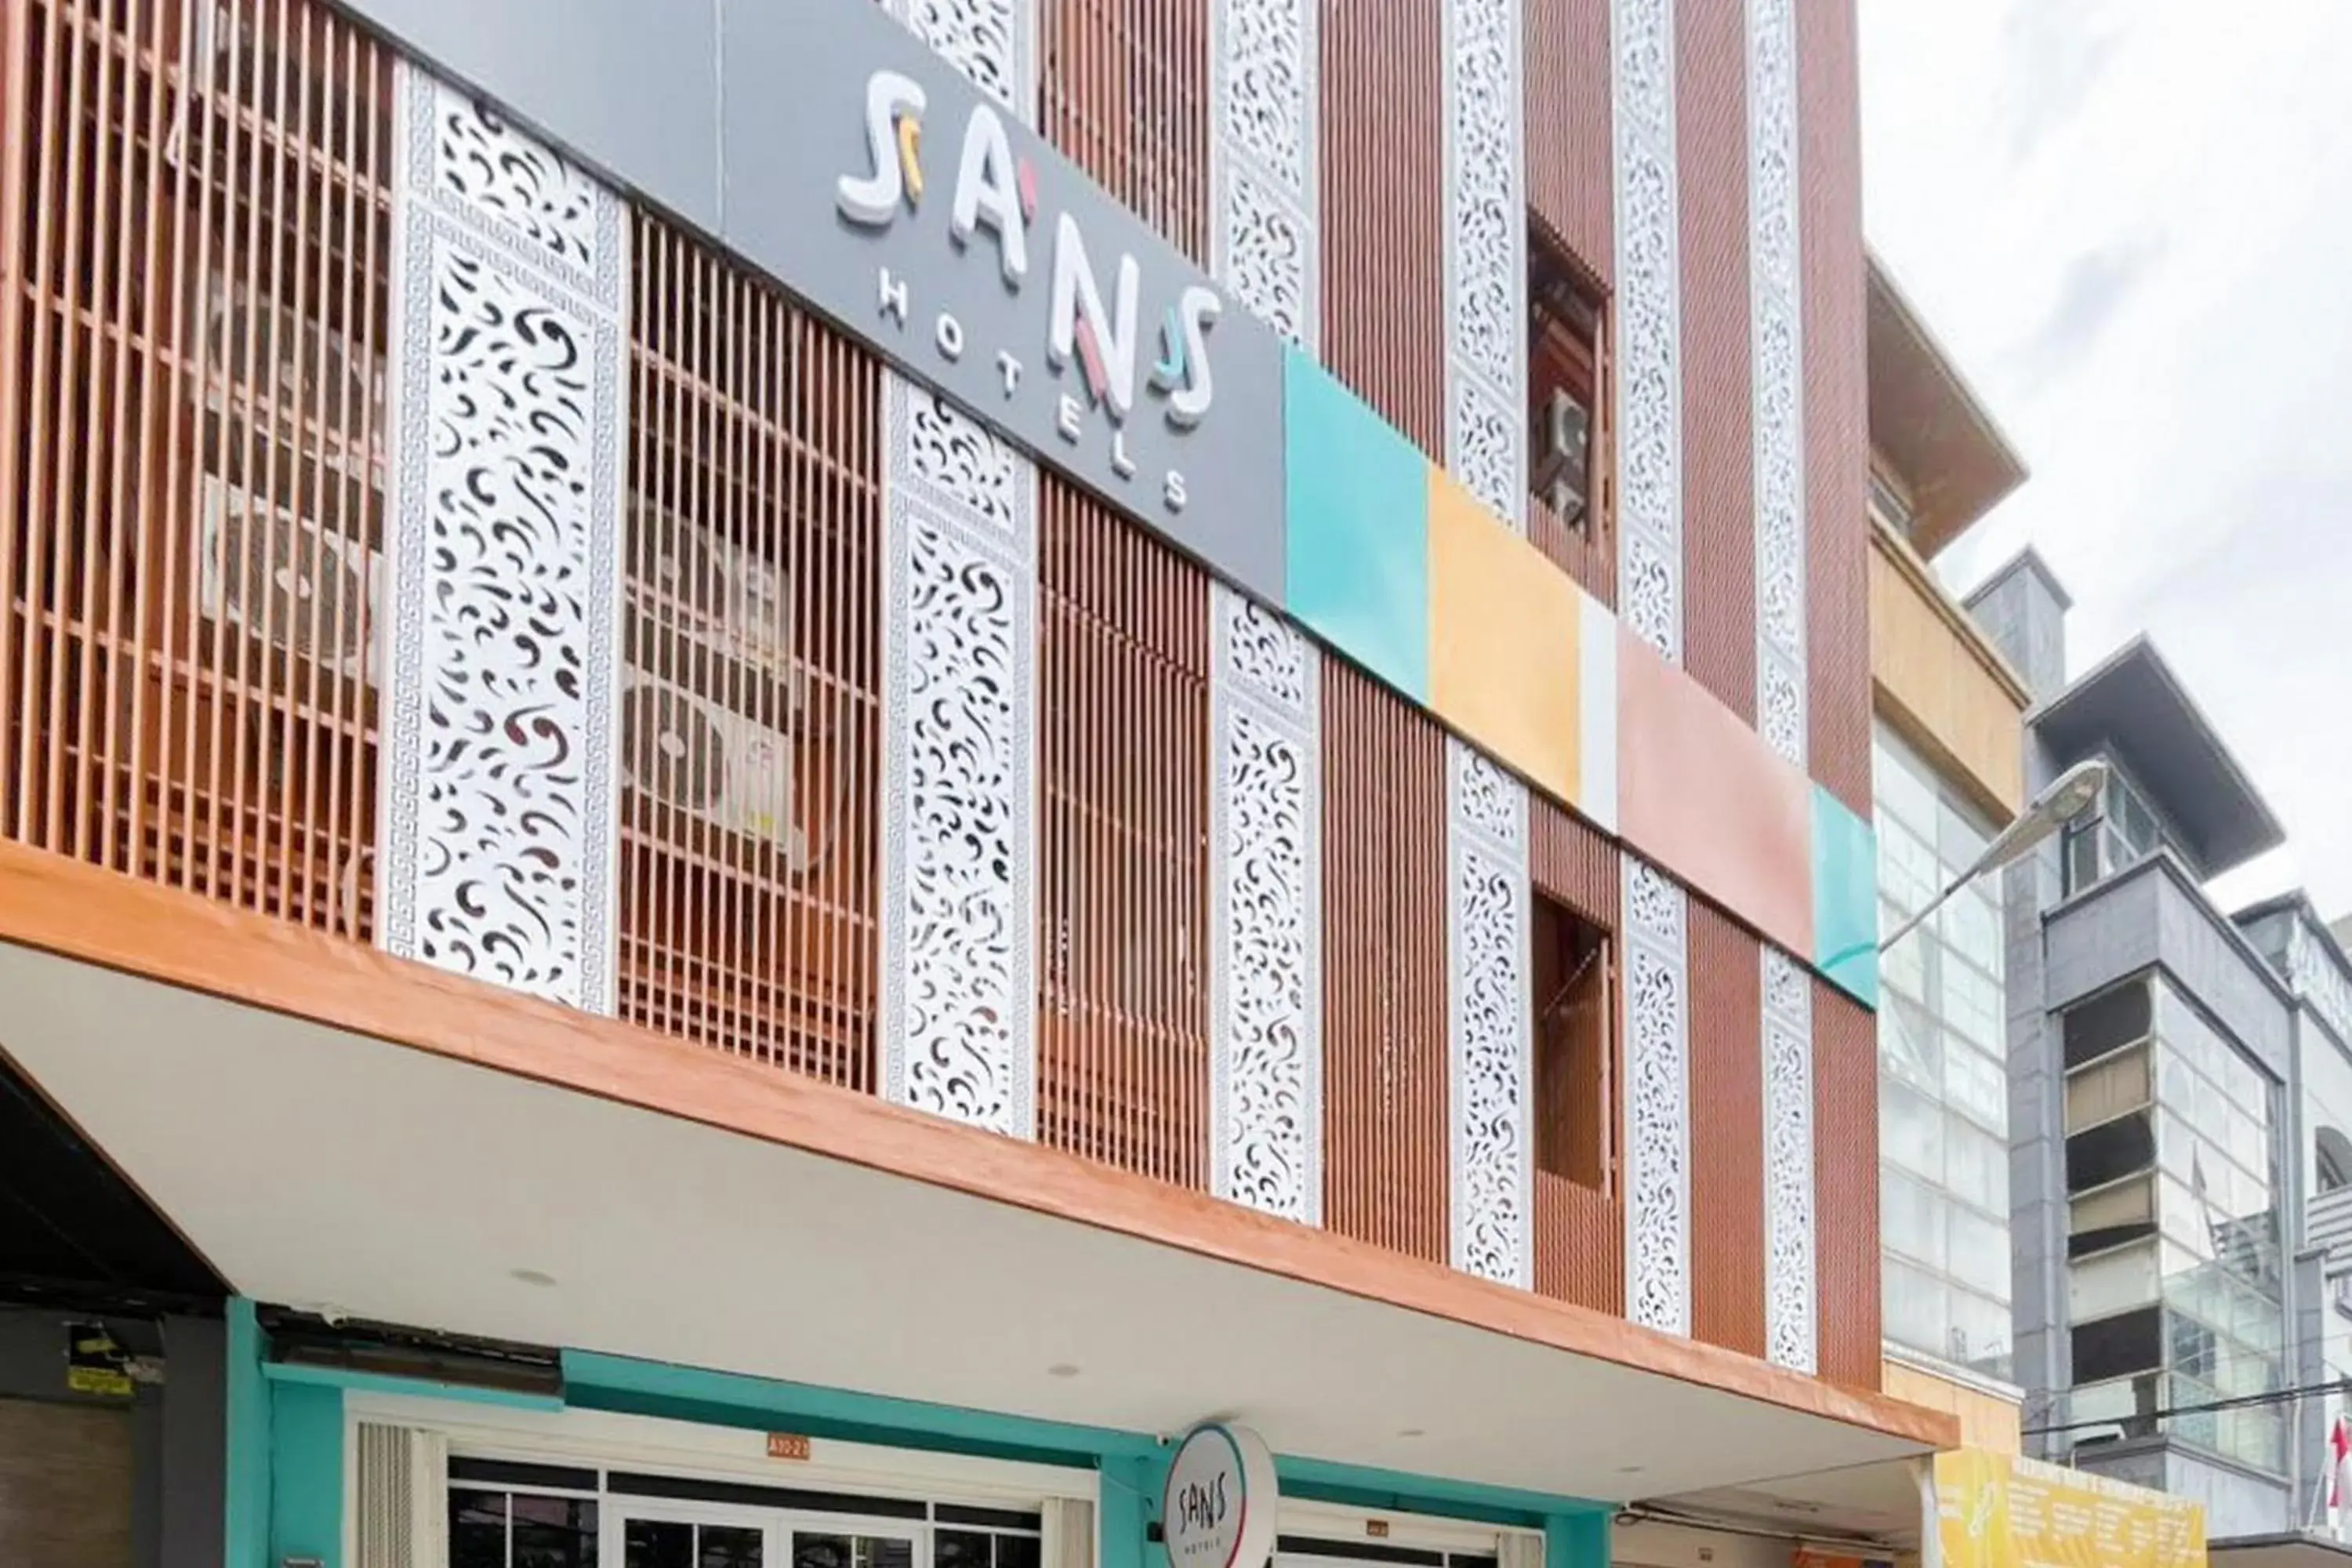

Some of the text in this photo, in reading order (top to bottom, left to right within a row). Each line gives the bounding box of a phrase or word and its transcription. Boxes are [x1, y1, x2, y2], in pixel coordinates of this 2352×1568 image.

[837, 70, 1221, 423] SANS
[878, 267, 1187, 508] HOTELS
[1179, 1471, 1226, 1534] SANS
